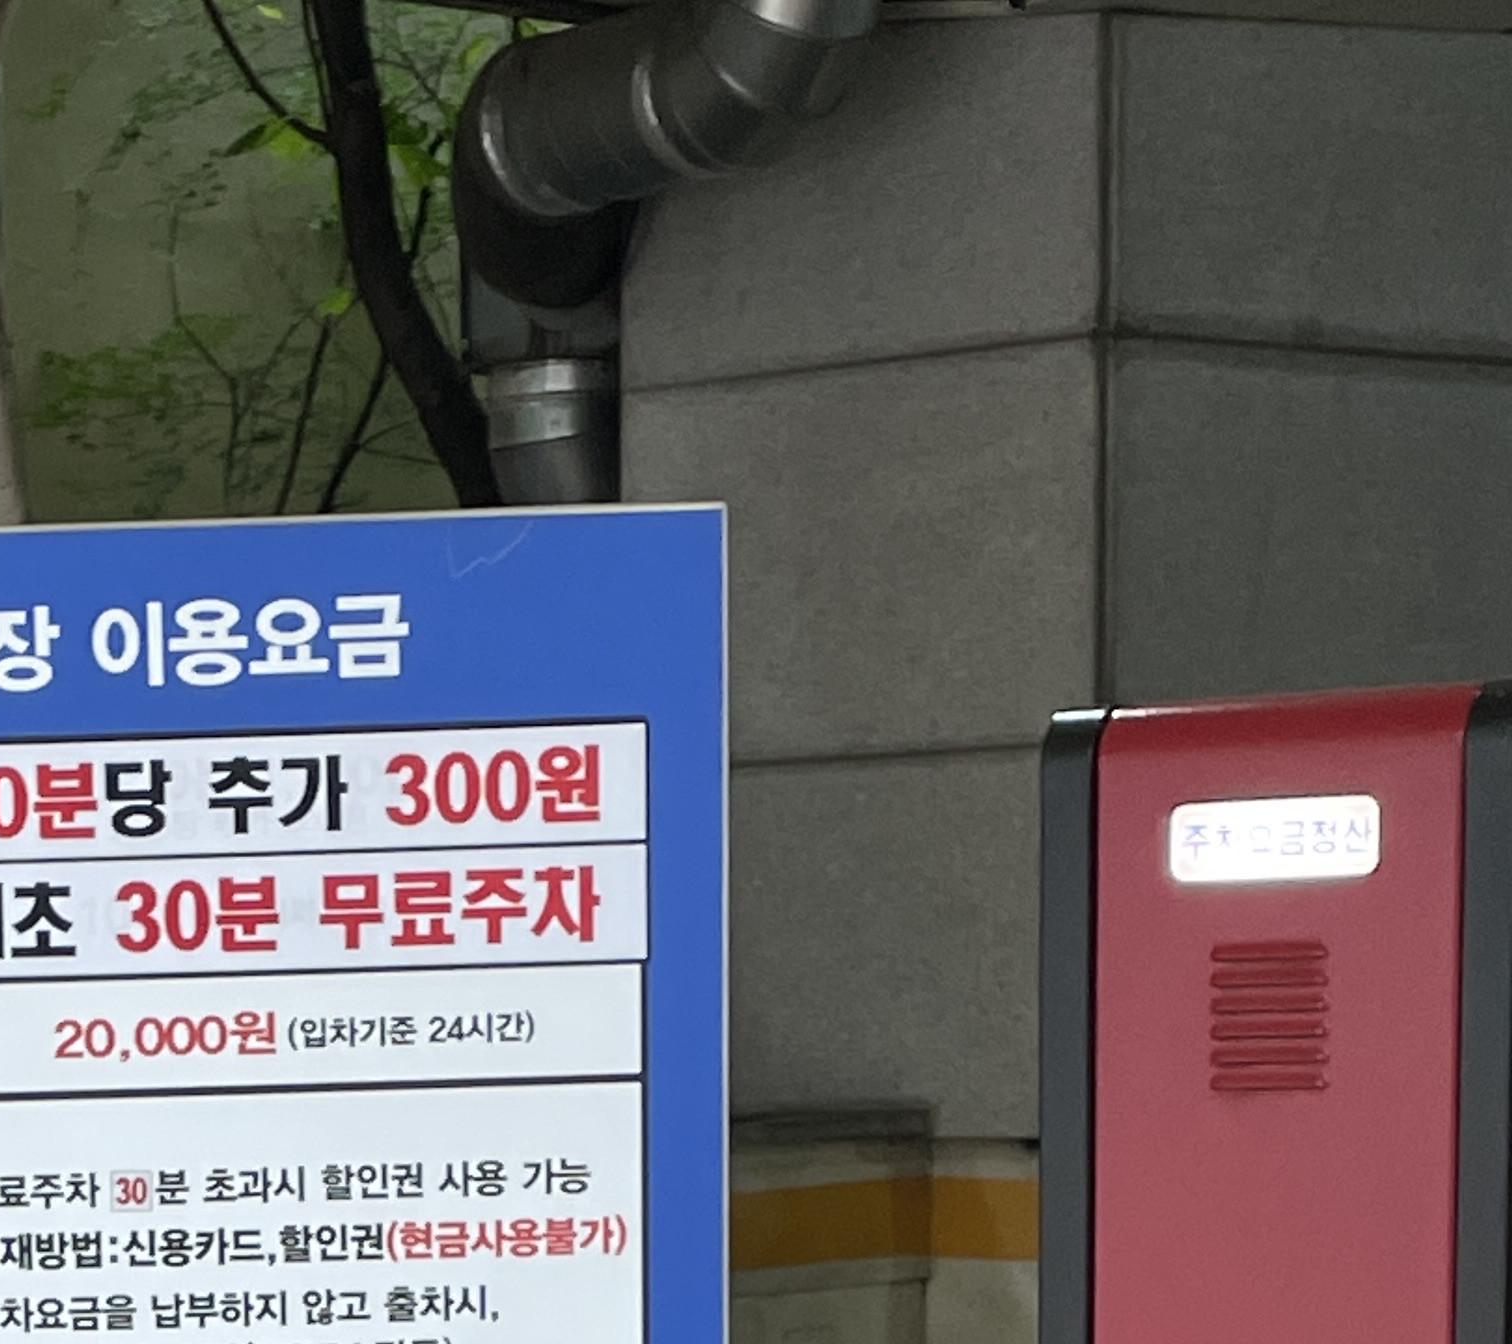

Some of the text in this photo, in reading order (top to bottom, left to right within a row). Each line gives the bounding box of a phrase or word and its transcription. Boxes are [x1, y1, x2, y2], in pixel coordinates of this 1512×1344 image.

[93, 595, 409, 685] 이용요금
[209, 755, 348, 834] 추가
[386, 745, 600, 825] 300원
[117, 877, 279, 952] 30분
[320, 866, 600, 949] 무료주차
[430, 1013, 534, 1042] 24시간)
[117, 1171, 189, 1204] 30분
[204, 1167, 304, 1203] 초과시
[322, 1163, 422, 1200] 할인권
[440, 1161, 506, 1196] 사용
[524, 1159, 590, 1194] 가능
[152, 1291, 286, 1328] 납부하지
[303, 1289, 370, 1325] 않고
[385, 1286, 498, 1322] 출차시,
